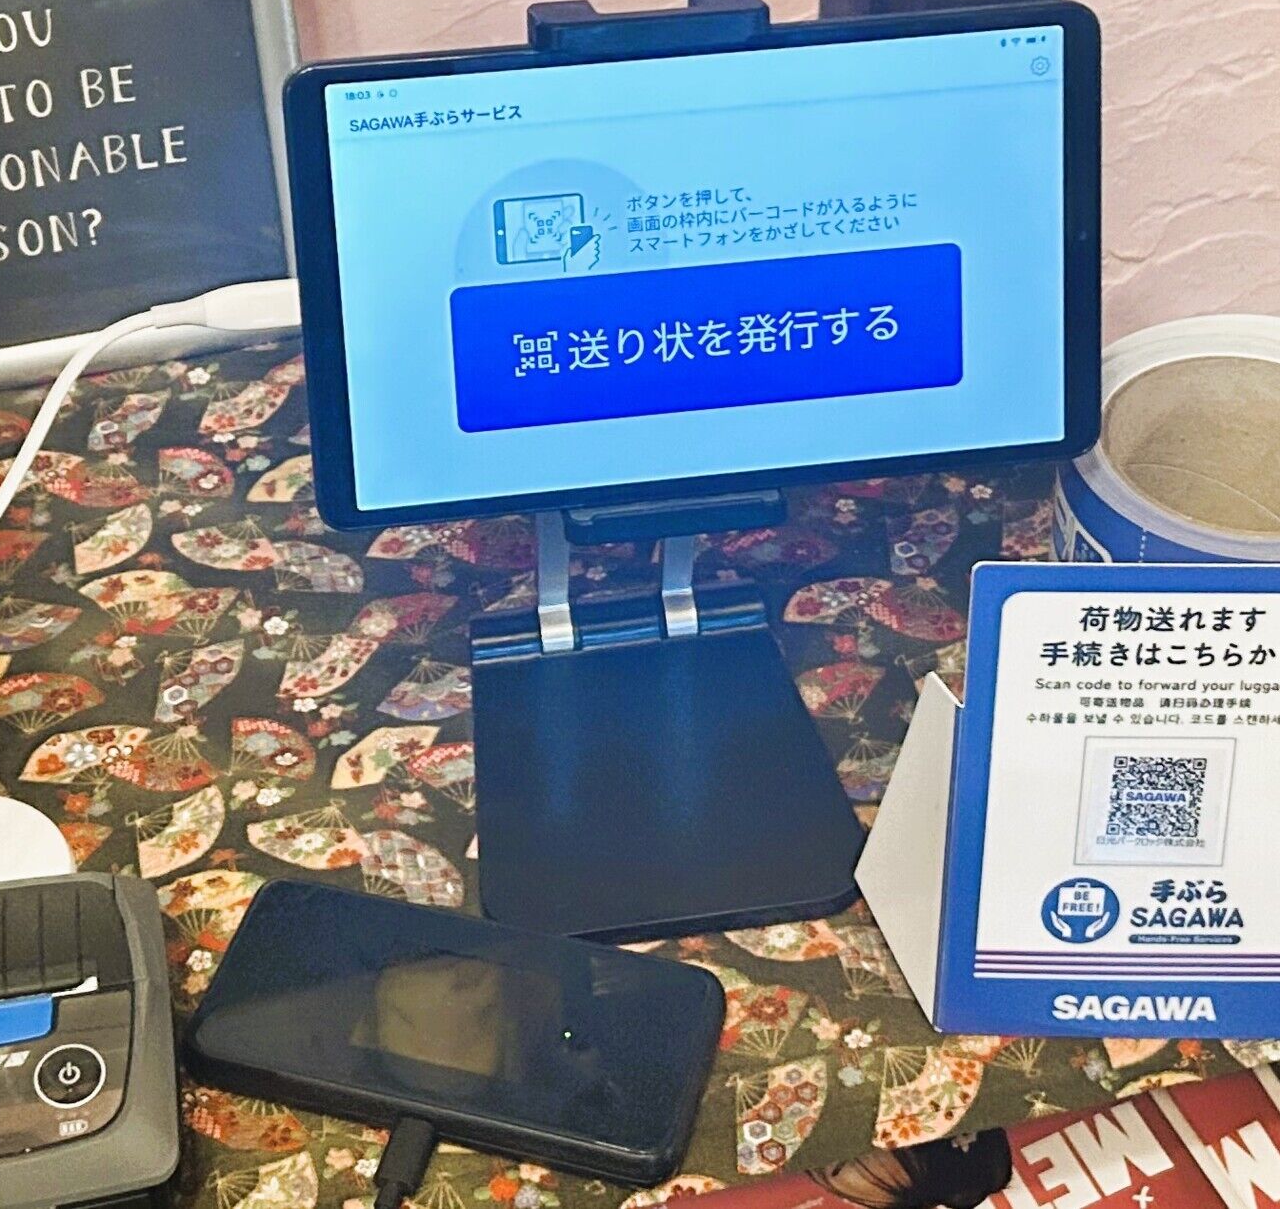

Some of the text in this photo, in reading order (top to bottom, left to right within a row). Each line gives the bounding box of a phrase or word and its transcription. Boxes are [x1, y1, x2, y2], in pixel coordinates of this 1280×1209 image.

[80, 63, 137, 109] BE
[345, 90, 371, 101] 18:03
[349, 104, 523, 132] SAGAWA手ぶらサービス
[625, 186, 753, 212] ボタンを押して、
[627, 192, 918, 234] 画面の枠内にバーコードが入るように
[629, 215, 901, 254] スマートフォンをかざしてください
[566, 301, 902, 373] 送り状を発行する
[1079, 605, 1268, 633] 荷物送れます
[1035, 678, 1071, 690] Scan
[1076, 679, 1112, 690] code
[1117, 679, 1133, 691] to
[1138, 679, 1197, 691] forward
[1201, 681, 1235, 694] your
[1125, 791, 1187, 802] SAGAWA
[1073, 891, 1090, 901] BE
[1150, 878, 1228, 904] 手ぶら
[1062, 902, 1101, 913] FREE!
[1129, 907, 1245, 929] SAGAWA
[1051, 994, 1218, 1022] SAGAWA
